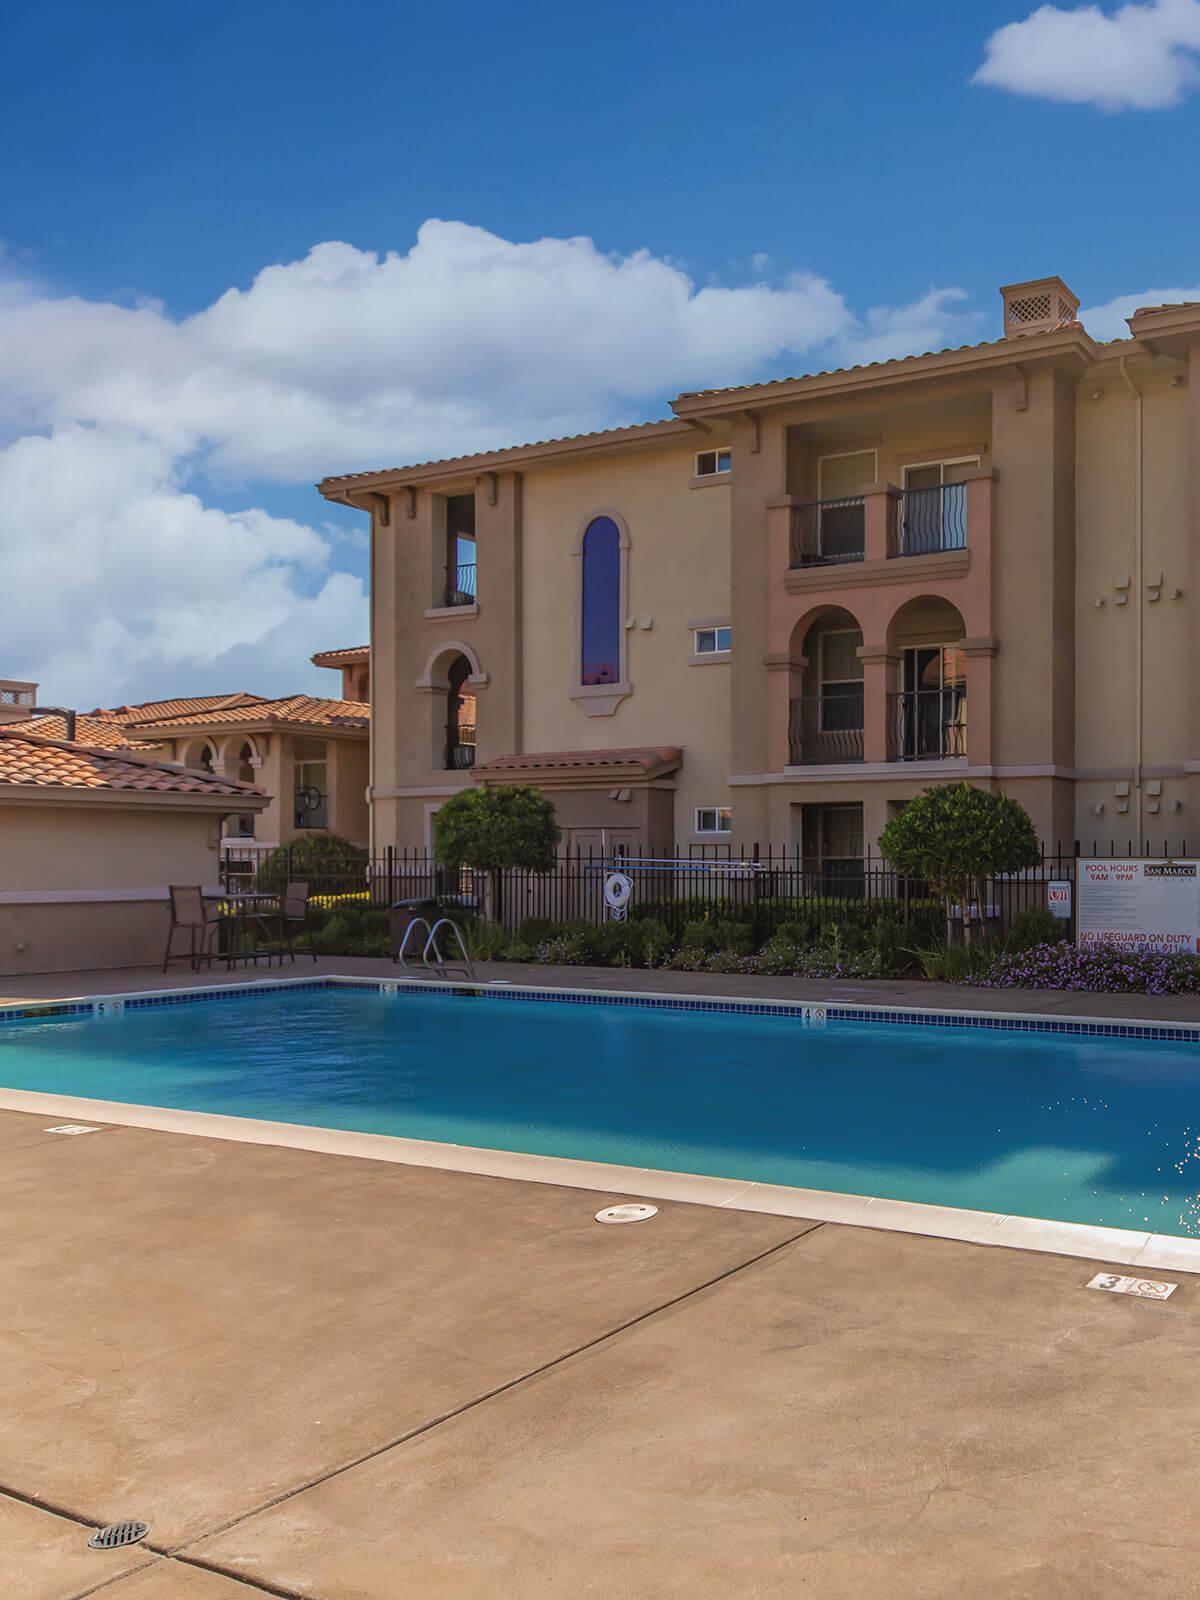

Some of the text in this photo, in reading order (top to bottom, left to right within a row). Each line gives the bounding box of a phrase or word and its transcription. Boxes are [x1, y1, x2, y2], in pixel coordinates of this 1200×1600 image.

[1085, 864, 1138, 872] POOL HOURS
[1145, 867, 1195, 875] SAN MARCO
[1080, 932, 1192, 944] NO LIFEGUARD ON DUTY
[1162, 943, 1179, 953] 911
[1099, 1275, 1121, 1289] 3
